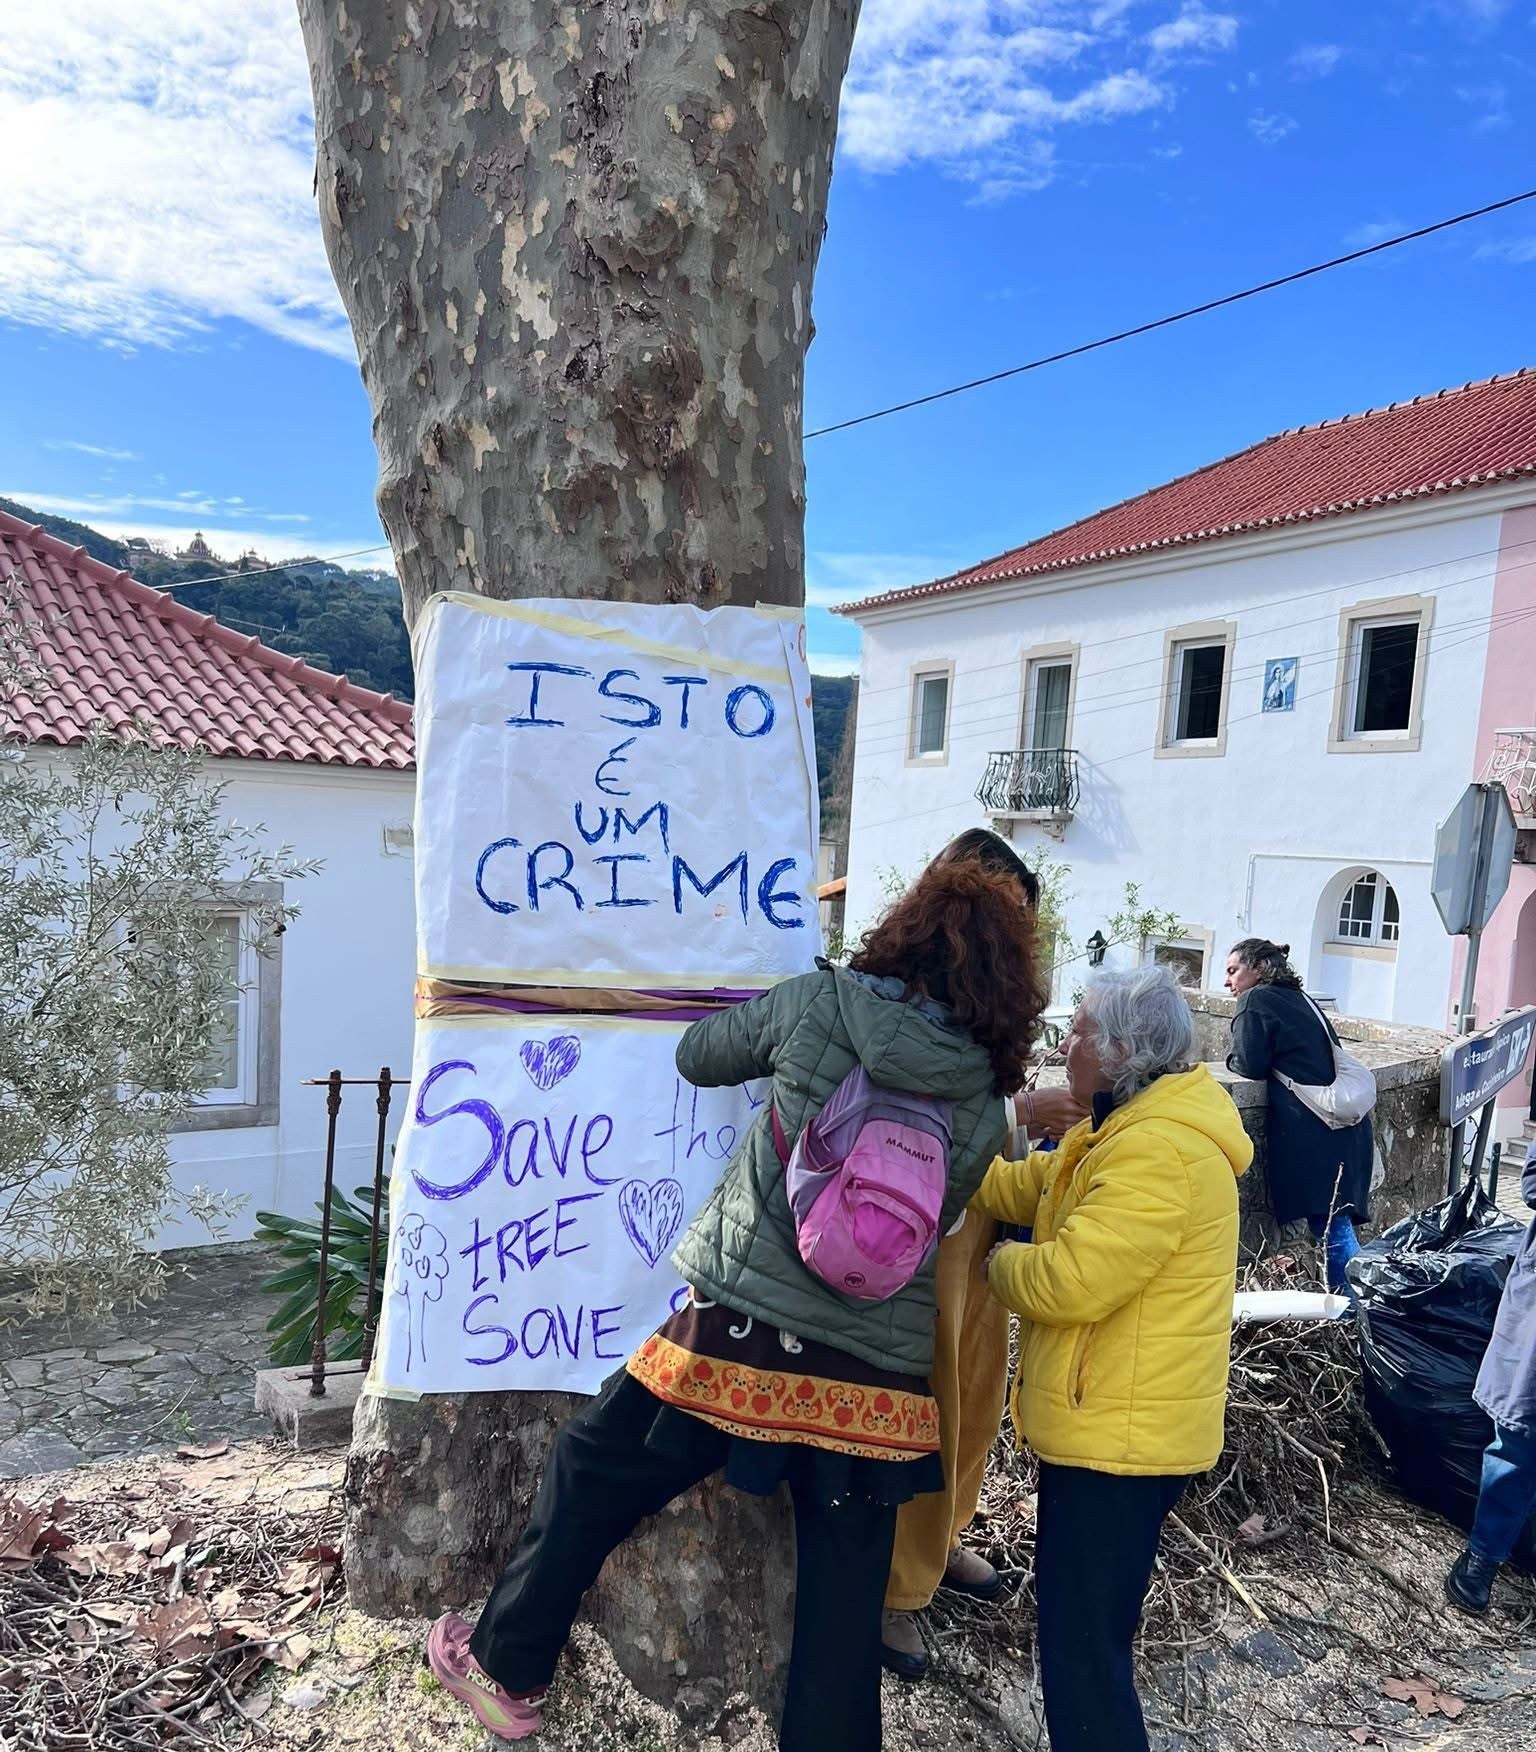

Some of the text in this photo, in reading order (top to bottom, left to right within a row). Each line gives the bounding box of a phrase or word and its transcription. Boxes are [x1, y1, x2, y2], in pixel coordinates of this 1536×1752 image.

[506, 661, 777, 738] ISTO
[595, 737, 640, 796] É
[574, 800, 671, 855] UM
[475, 837, 806, 930] CRIME
[411, 1058, 737, 1200] Save the
[885, 1136, 936, 1164] MAMMUT
[466, 1667, 498, 1696] HOKA
